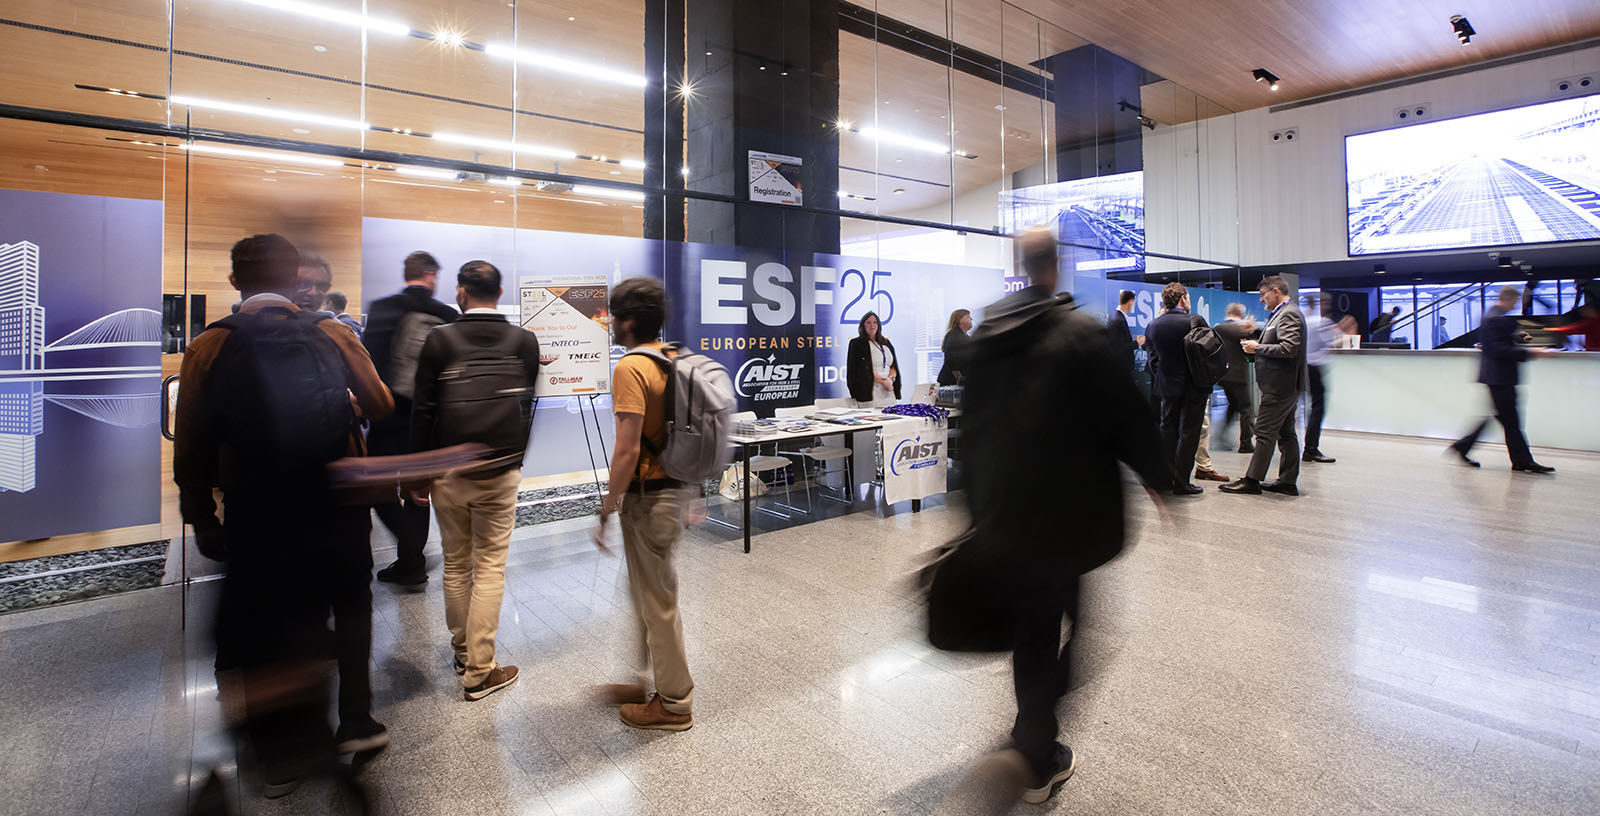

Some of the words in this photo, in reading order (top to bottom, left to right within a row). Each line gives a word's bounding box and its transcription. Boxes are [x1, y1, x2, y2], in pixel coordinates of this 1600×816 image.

[754, 186, 791, 197] Registration
[569, 289, 606, 299] ESF25
[701, 259, 895, 327] ESF25
[700, 337, 789, 351] EUROPEAN
[797, 335, 841, 348] STEEL
[744, 364, 804, 382] AIST
[754, 391, 799, 401] EUROPEAN
[897, 442, 942, 462] AIST
